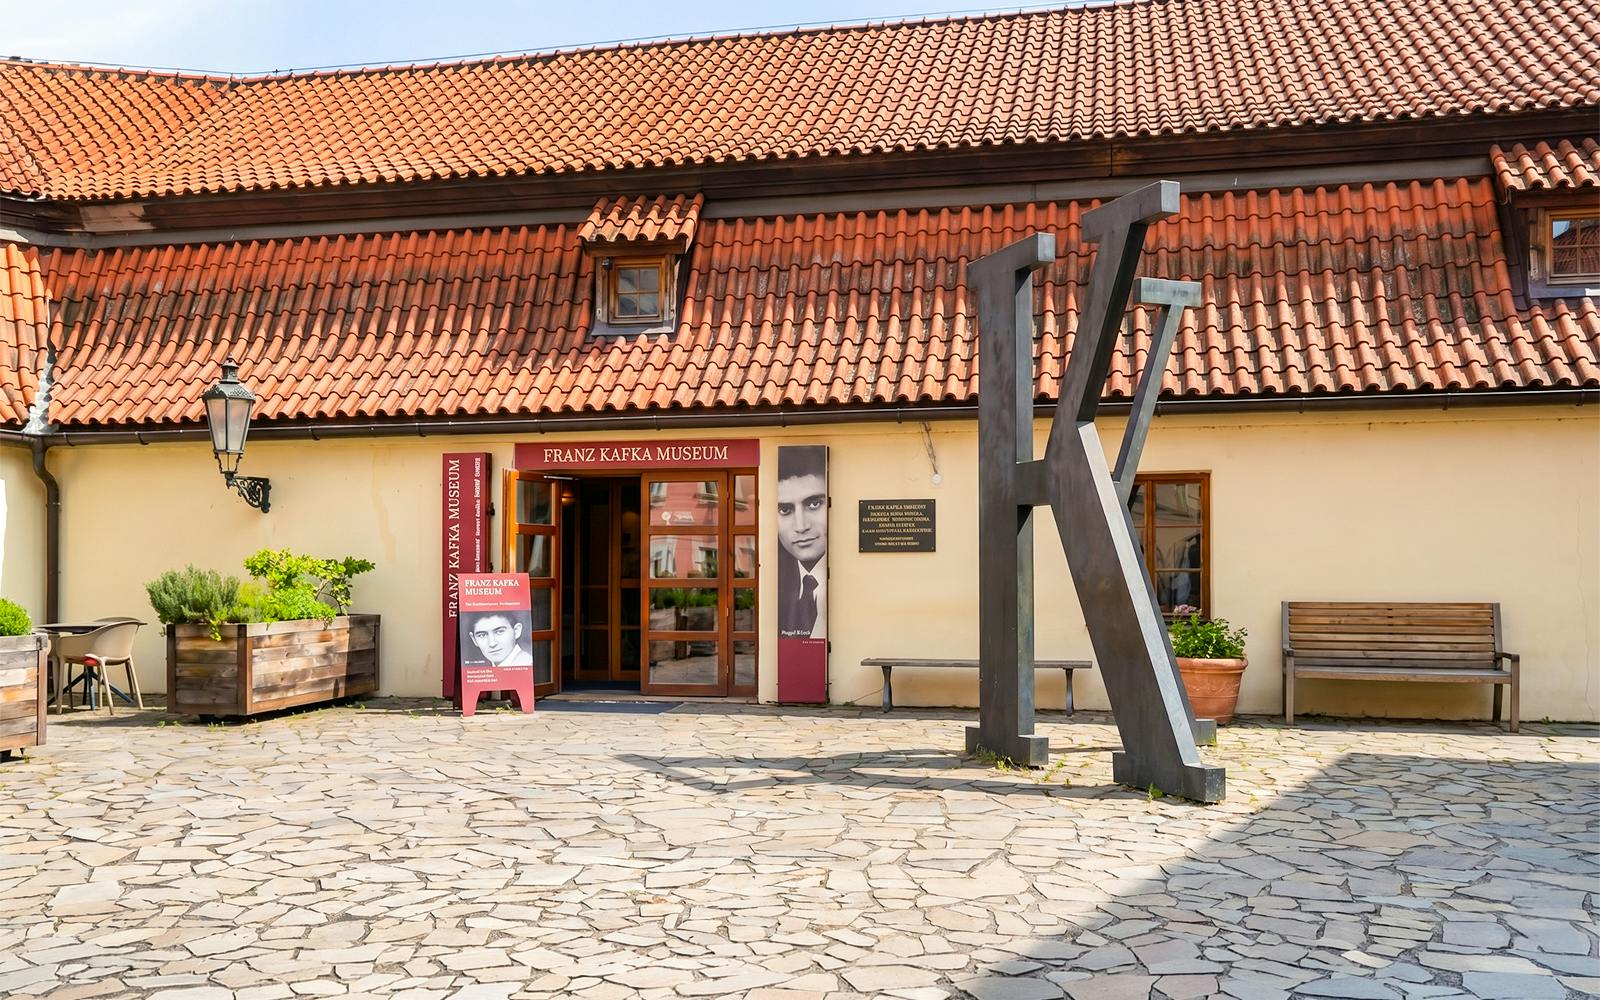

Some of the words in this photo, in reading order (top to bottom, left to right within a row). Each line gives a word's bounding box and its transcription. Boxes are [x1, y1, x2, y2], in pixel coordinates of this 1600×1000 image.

[543, 448, 595, 463] FRANZ
[599, 447, 653, 462] KAFKA
[656, 446, 729, 461] MUSEUM
[448, 459, 460, 519] MUSEUM
[448, 523, 460, 569] KAFKA
[448, 573, 460, 618] FRANZ
[465, 579, 492, 587] FRANZ
[493, 579, 520, 587] KAFKA
[465, 587, 502, 596] MUSEUM
